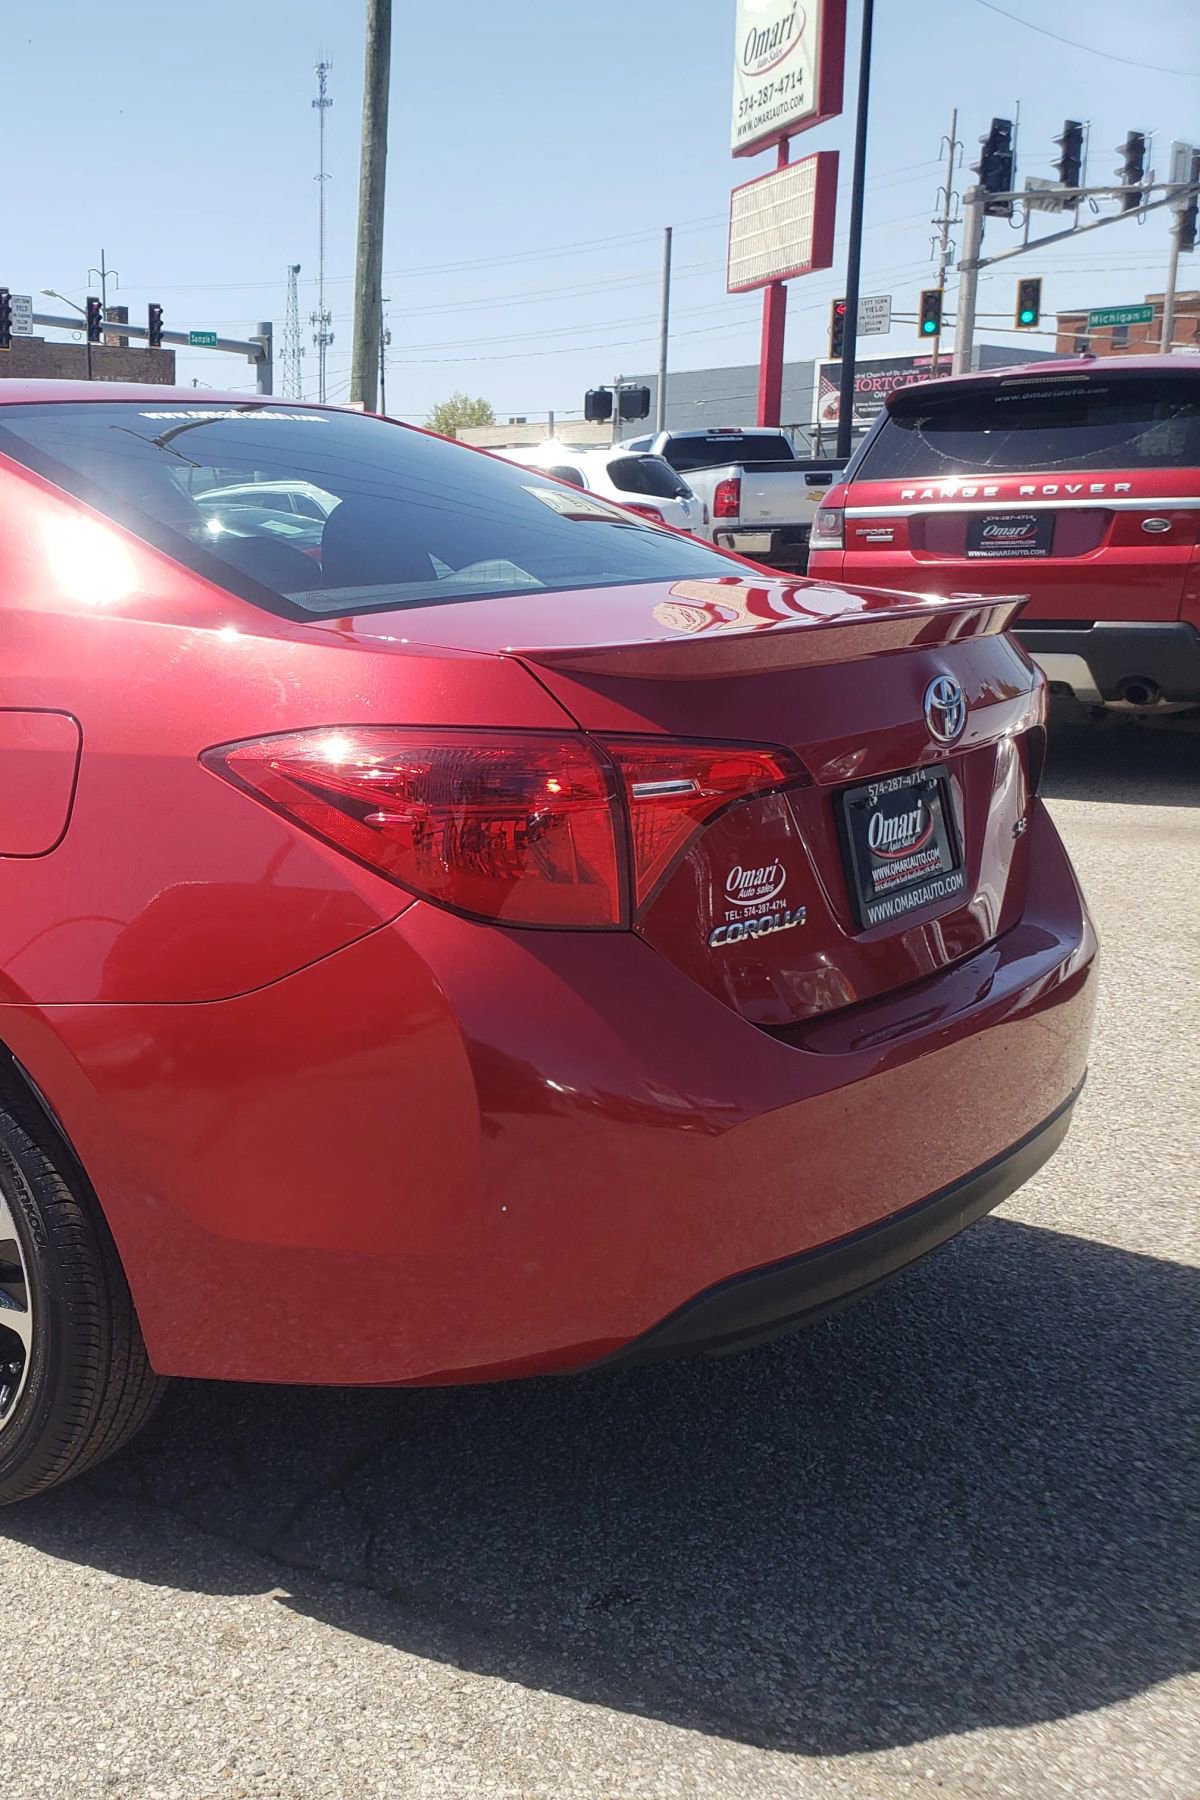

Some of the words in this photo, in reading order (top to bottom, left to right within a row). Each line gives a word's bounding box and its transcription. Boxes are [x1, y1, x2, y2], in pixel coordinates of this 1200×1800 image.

[743, 1, 798, 66] Omari
[739, 67, 803, 118] 574-287-4714
[737, 93, 804, 137] WWW.OMARIAUTO.COM
[1091, 312, 1140, 325] Michigan
[873, 391, 886, 399] ON
[994, 387, 1110, 402] www.omariauto.com
[901, 485, 999, 500] RANGE
[1019, 482, 1132, 497] ROVER
[855, 527, 895, 536] SPORT
[982, 523, 1031, 537] Omari
[967, 549, 1046, 557] WWW.OMARIAUTO.COM
[868, 770, 926, 797] 574-287-4714
[868, 799, 922, 848] Omari
[726, 858, 779, 892] Omari
[872, 848, 940, 882] WWW.OMARIAUTO.COM
[737, 887, 755, 899] Auto
[756, 883, 775, 895] sales
[868, 873, 964, 924] WWW.OMARIAUTO.COM
[724, 910, 742, 921] TEL:
[743, 898, 787, 917] 574-287-4714
[709, 906, 806, 948] COROLLA
